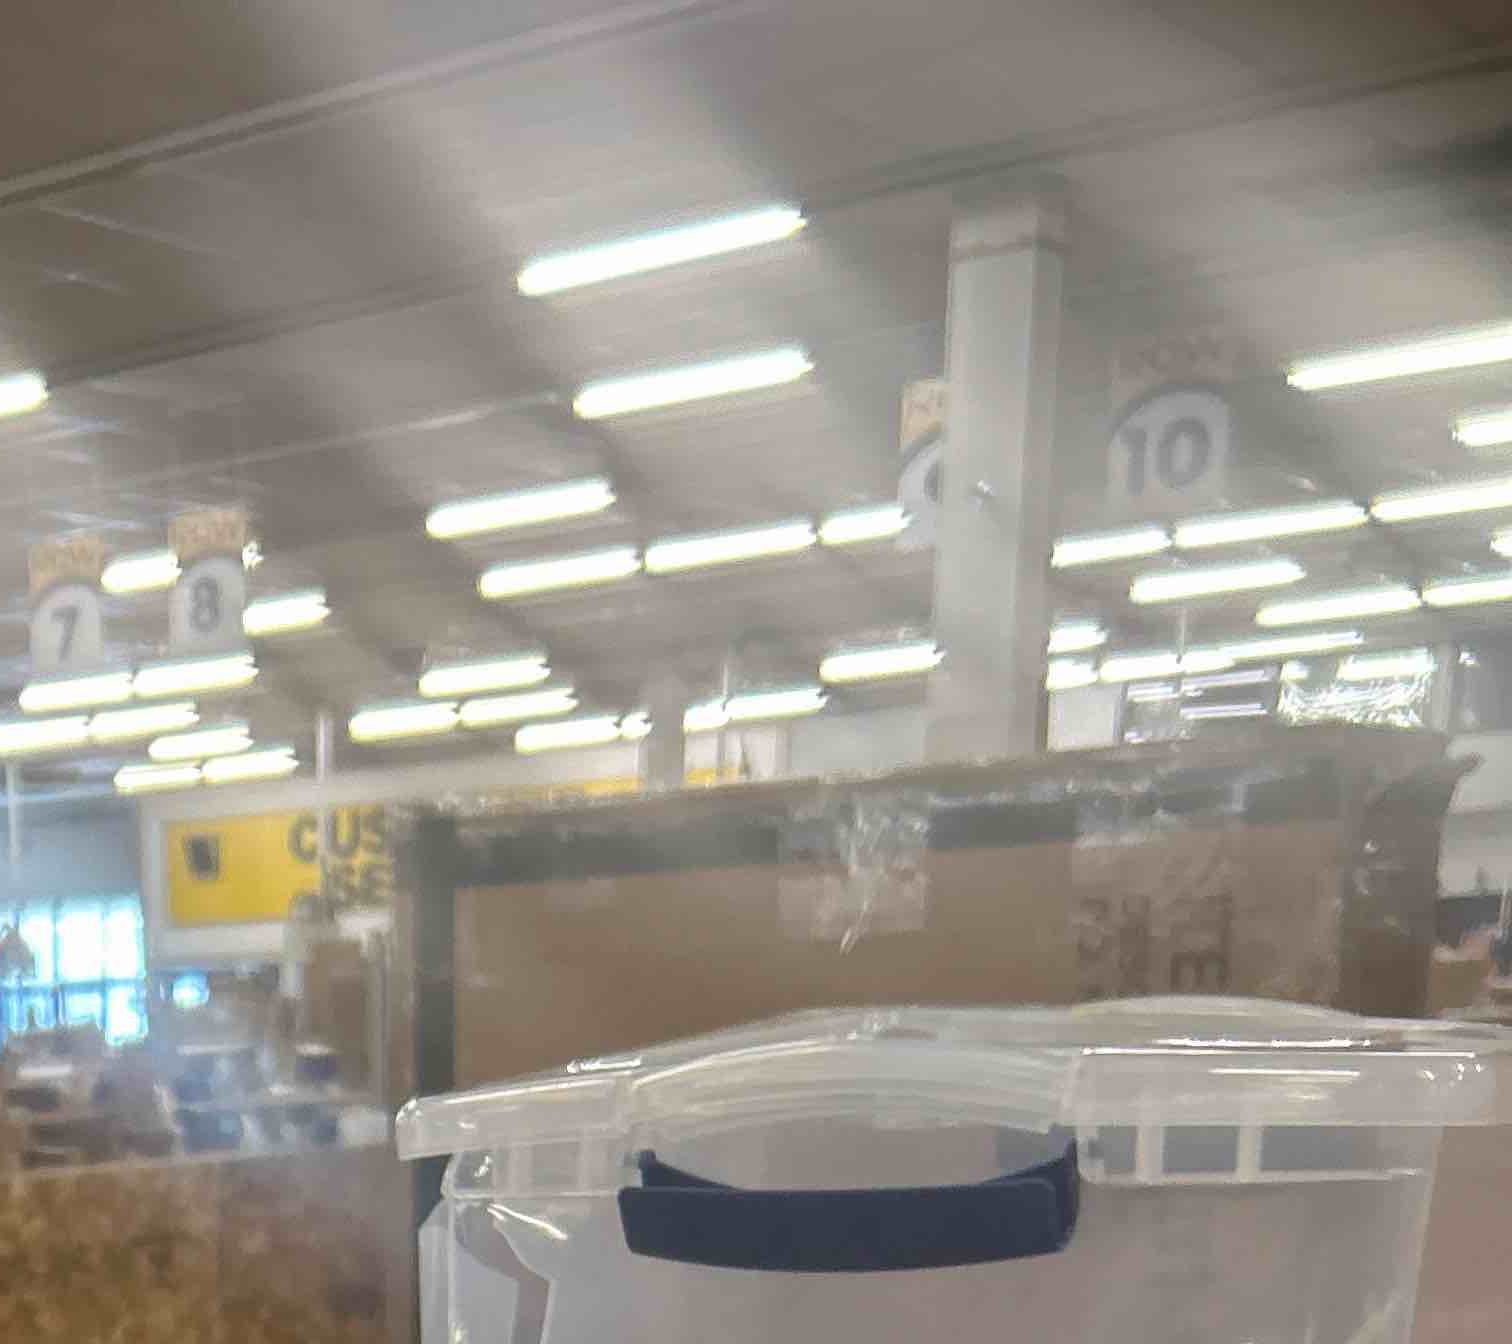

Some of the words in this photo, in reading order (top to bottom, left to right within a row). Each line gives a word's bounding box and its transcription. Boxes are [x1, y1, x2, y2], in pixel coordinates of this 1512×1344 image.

[1120, 418, 1211, 494] 10
[188, 574, 223, 633] 8
[50, 604, 82, 663] 7
